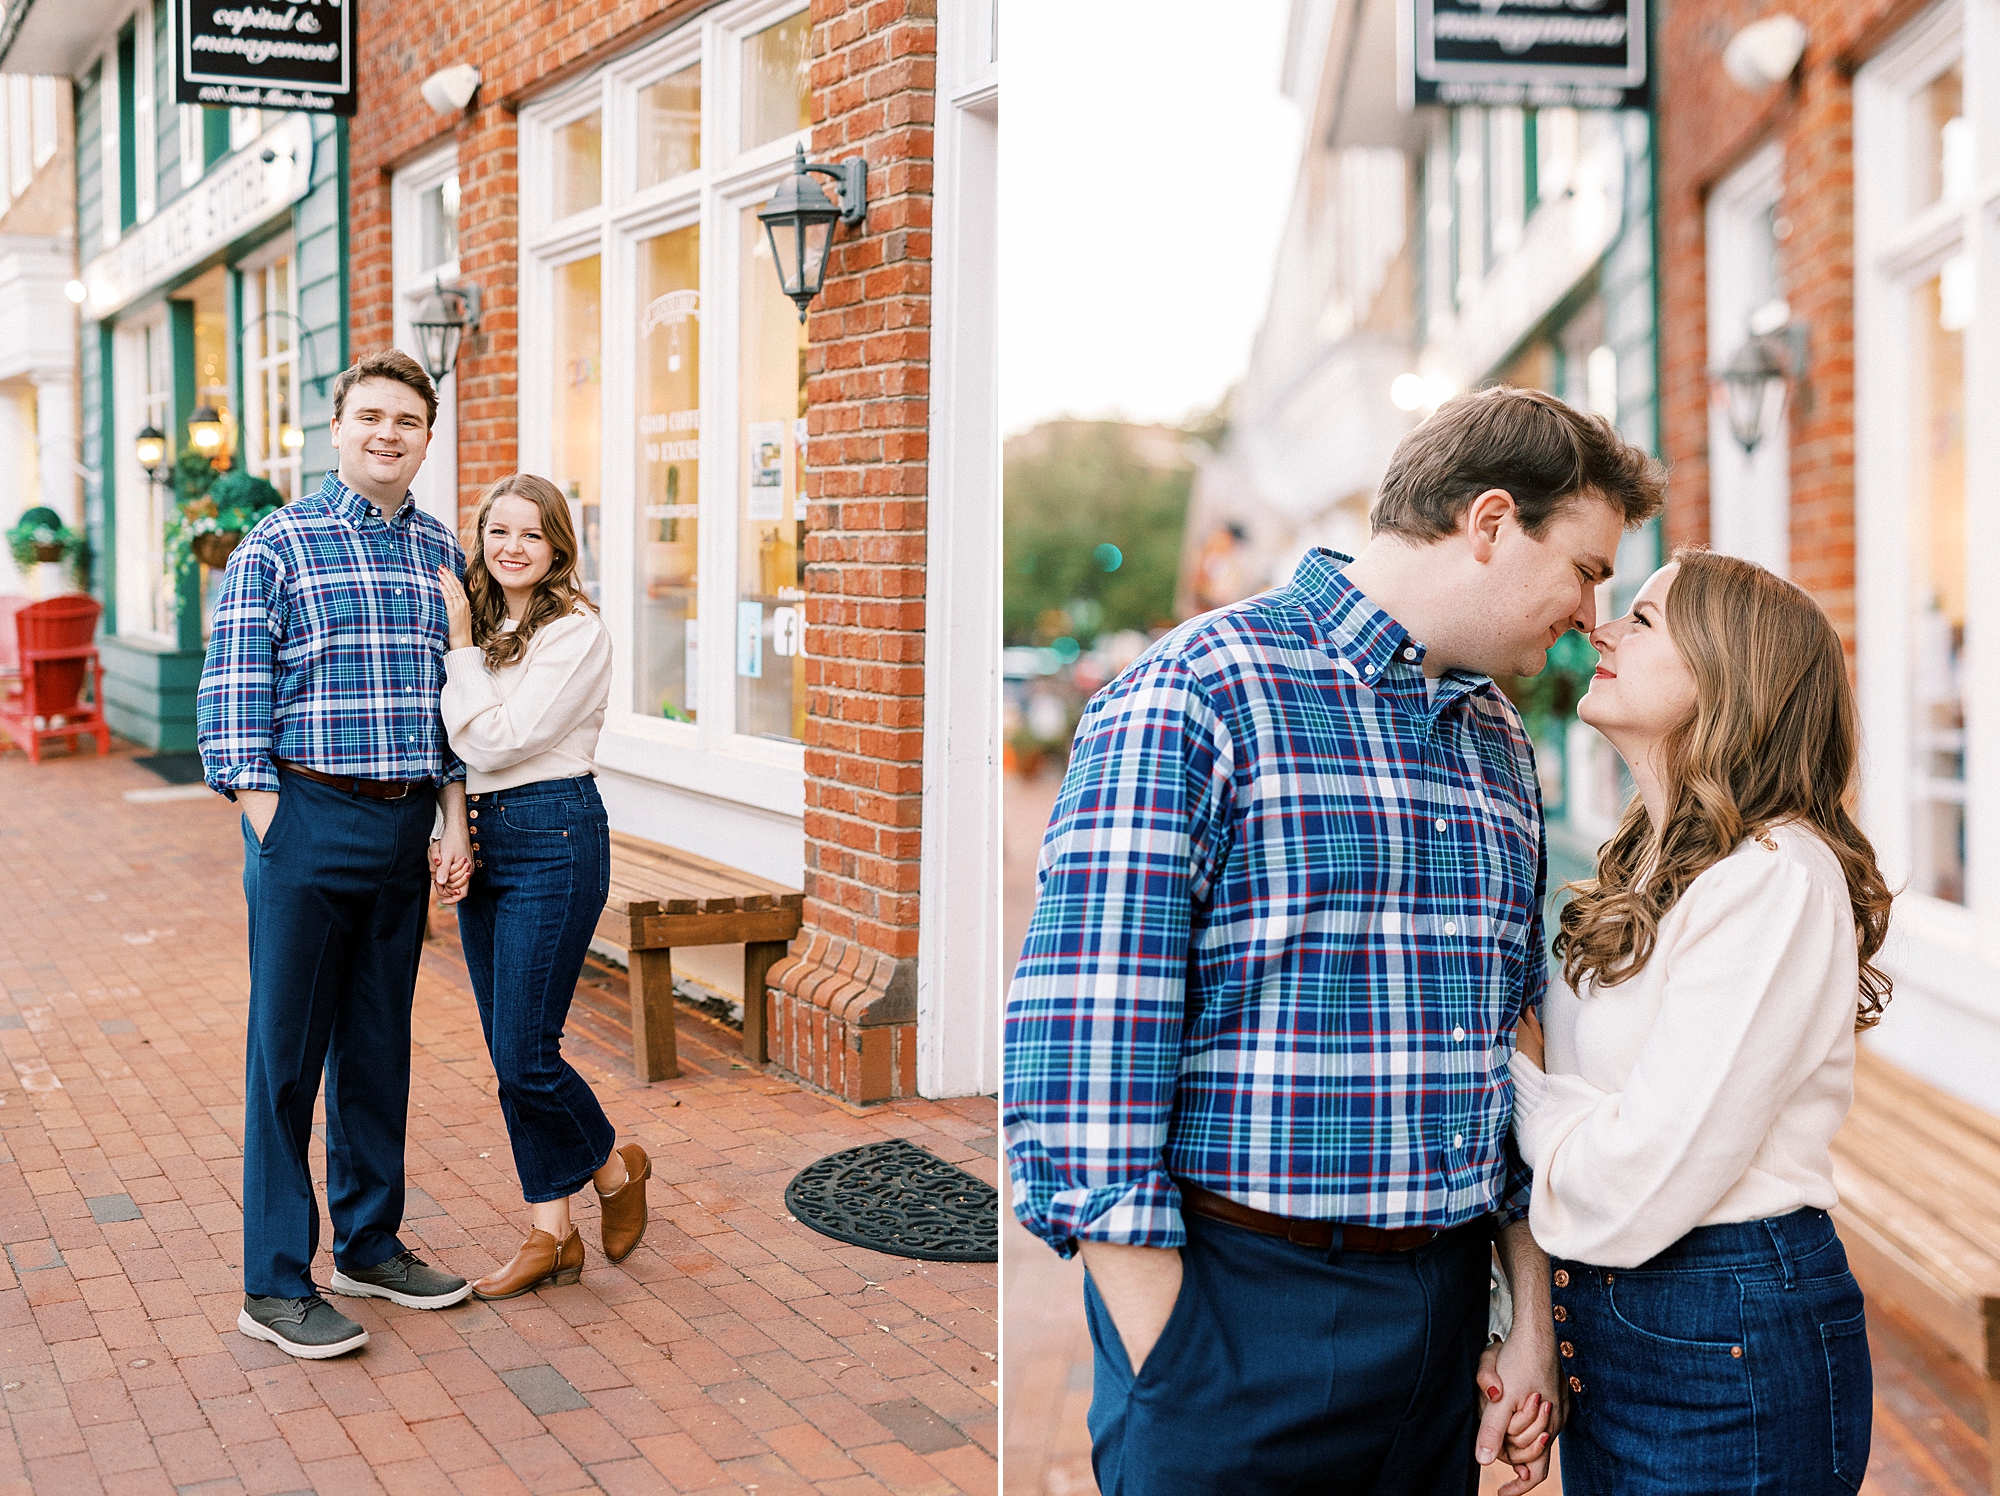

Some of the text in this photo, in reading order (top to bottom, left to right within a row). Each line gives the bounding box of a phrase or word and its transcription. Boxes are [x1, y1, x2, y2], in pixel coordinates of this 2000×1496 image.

[213, 6, 322, 35] capital &
[192, 34, 340, 64] management
[669, 409, 699, 432] COFFE
[661, 439, 699, 462] EXCUSE
